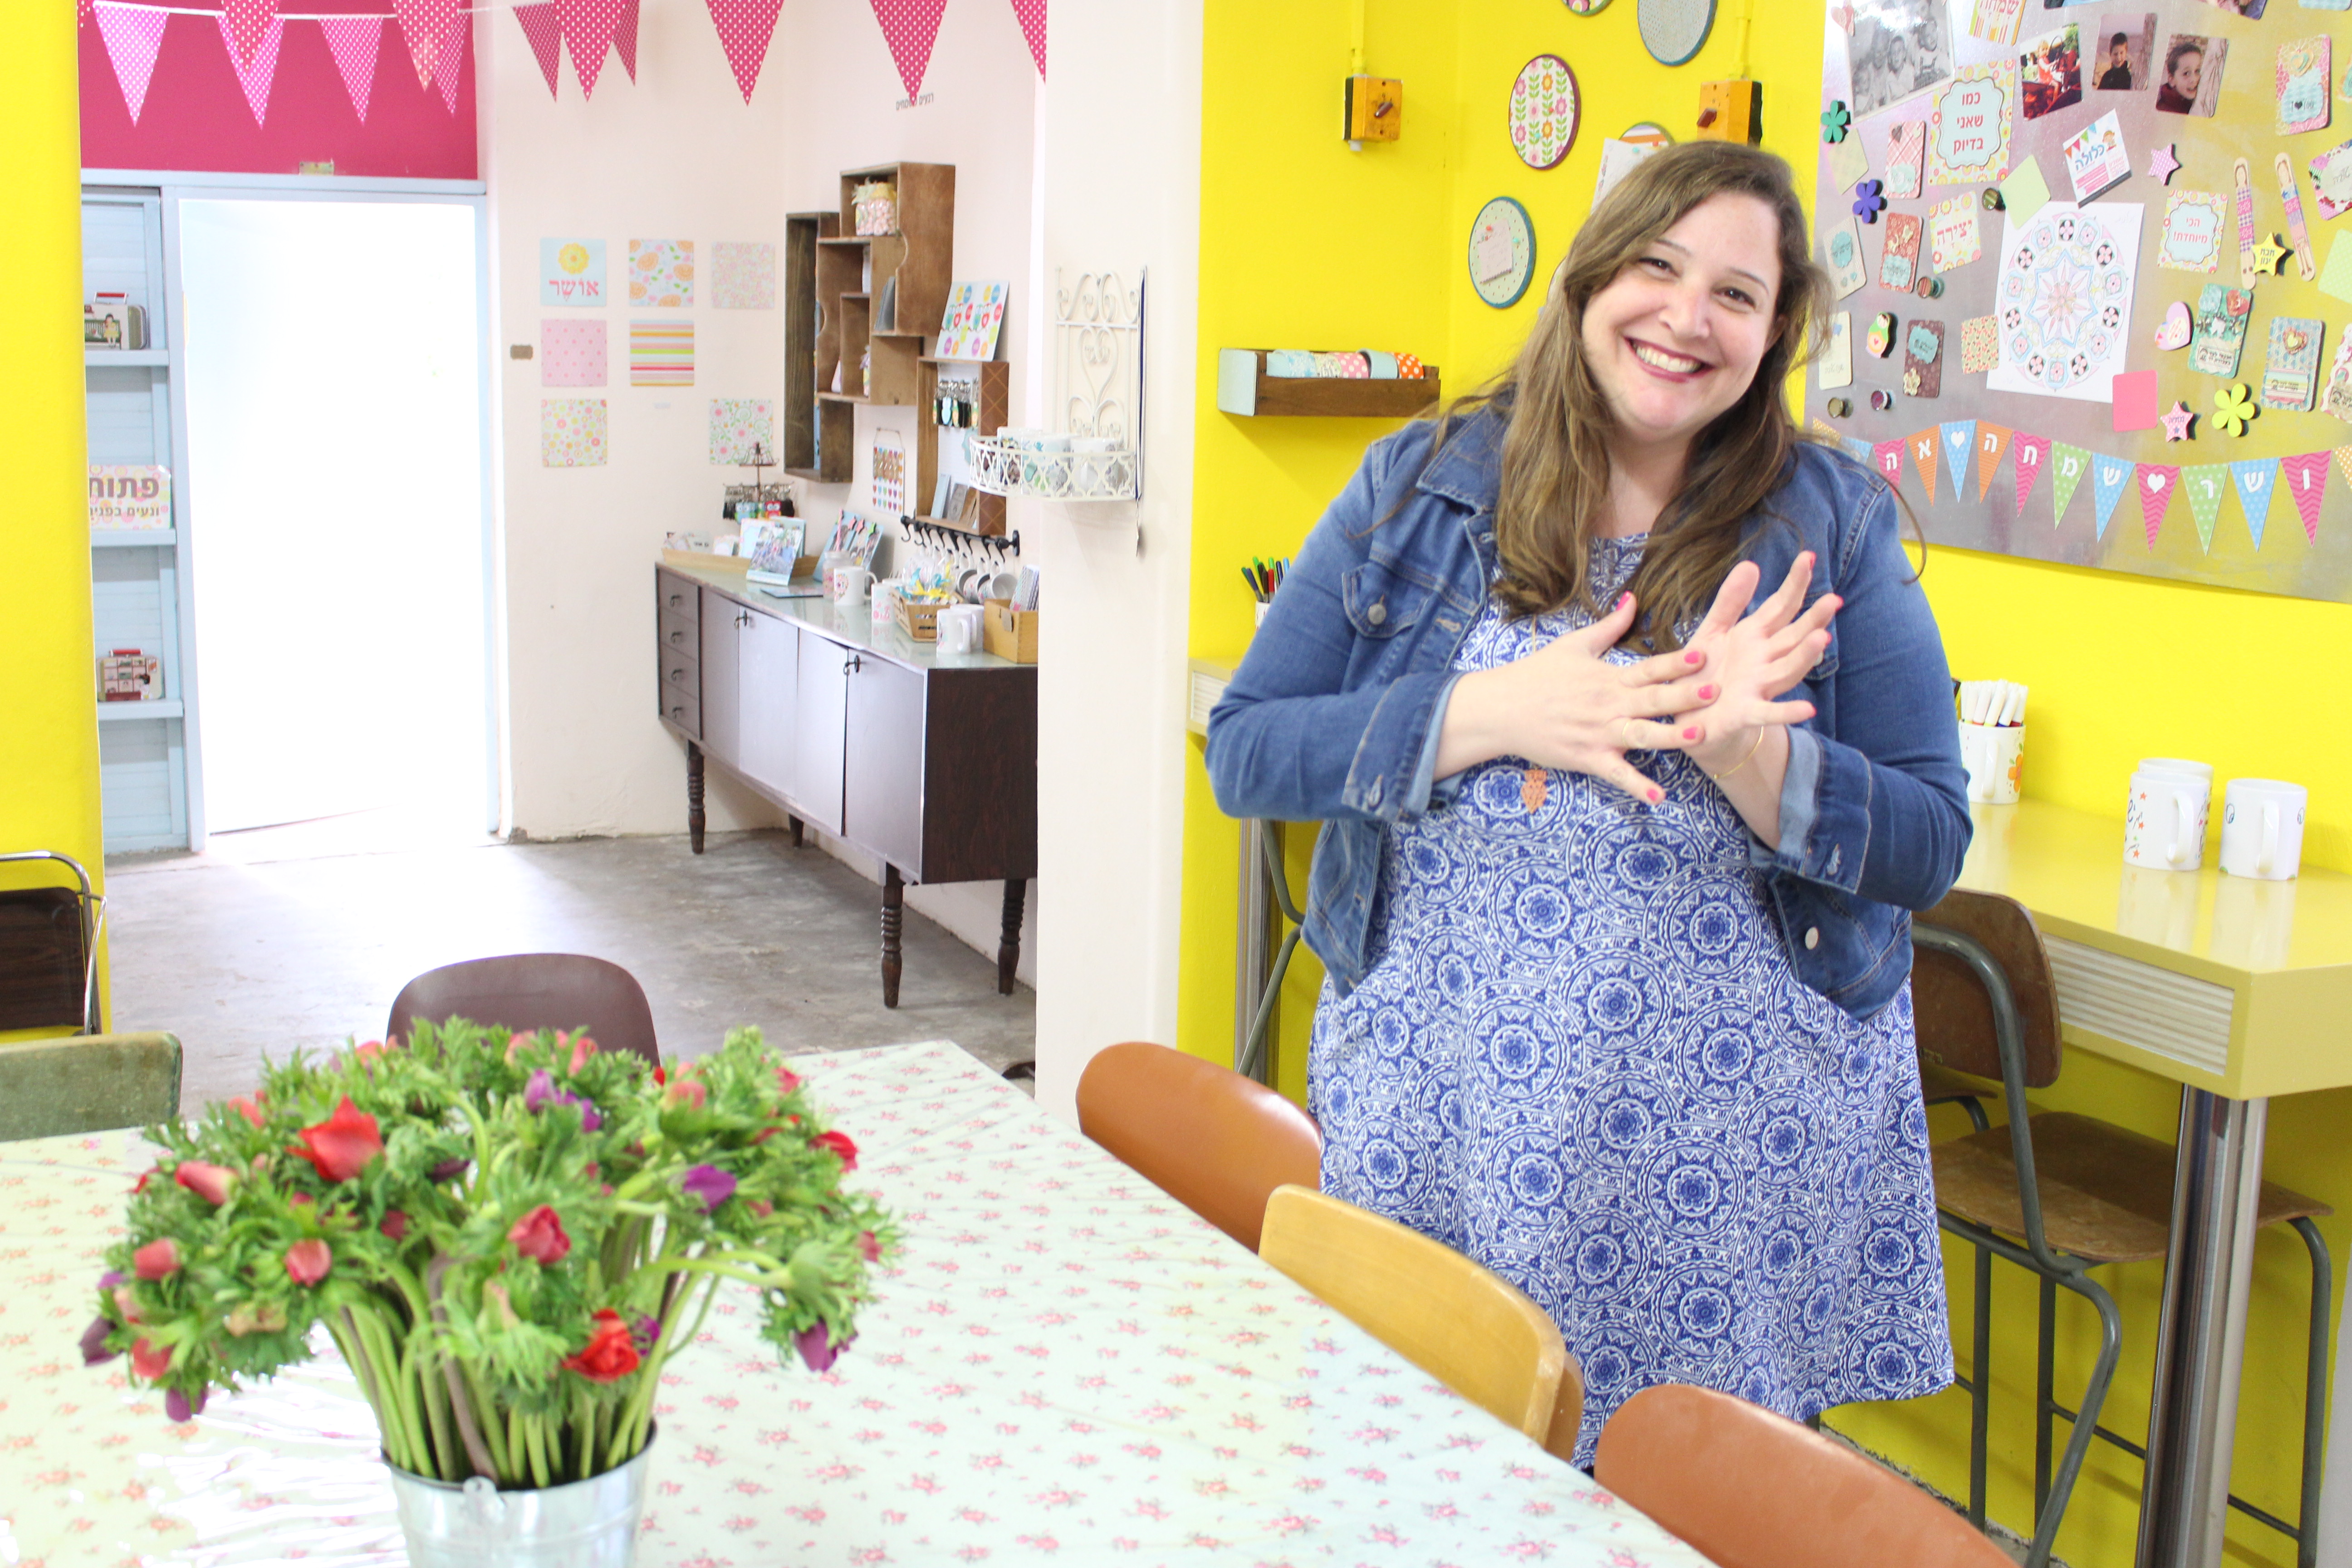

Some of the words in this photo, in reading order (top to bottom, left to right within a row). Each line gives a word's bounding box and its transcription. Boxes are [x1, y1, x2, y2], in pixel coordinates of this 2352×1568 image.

[1962, 92, 1980, 106] כמו
[1956, 115, 1984, 129] שאני
[1953, 137, 1984, 155] בדיוק
[2075, 144, 2105, 171] כלולה
[2186, 217, 2201, 228] הכי
[1937, 219, 1972, 246] יצירה
[2173, 231, 2208, 244] מיוחדת!
[548, 279, 599, 297] אושר
[1984, 433, 2121, 487] שמחה
[89, 478, 159, 498] פתוח
[127, 507, 160, 517] ונעים
